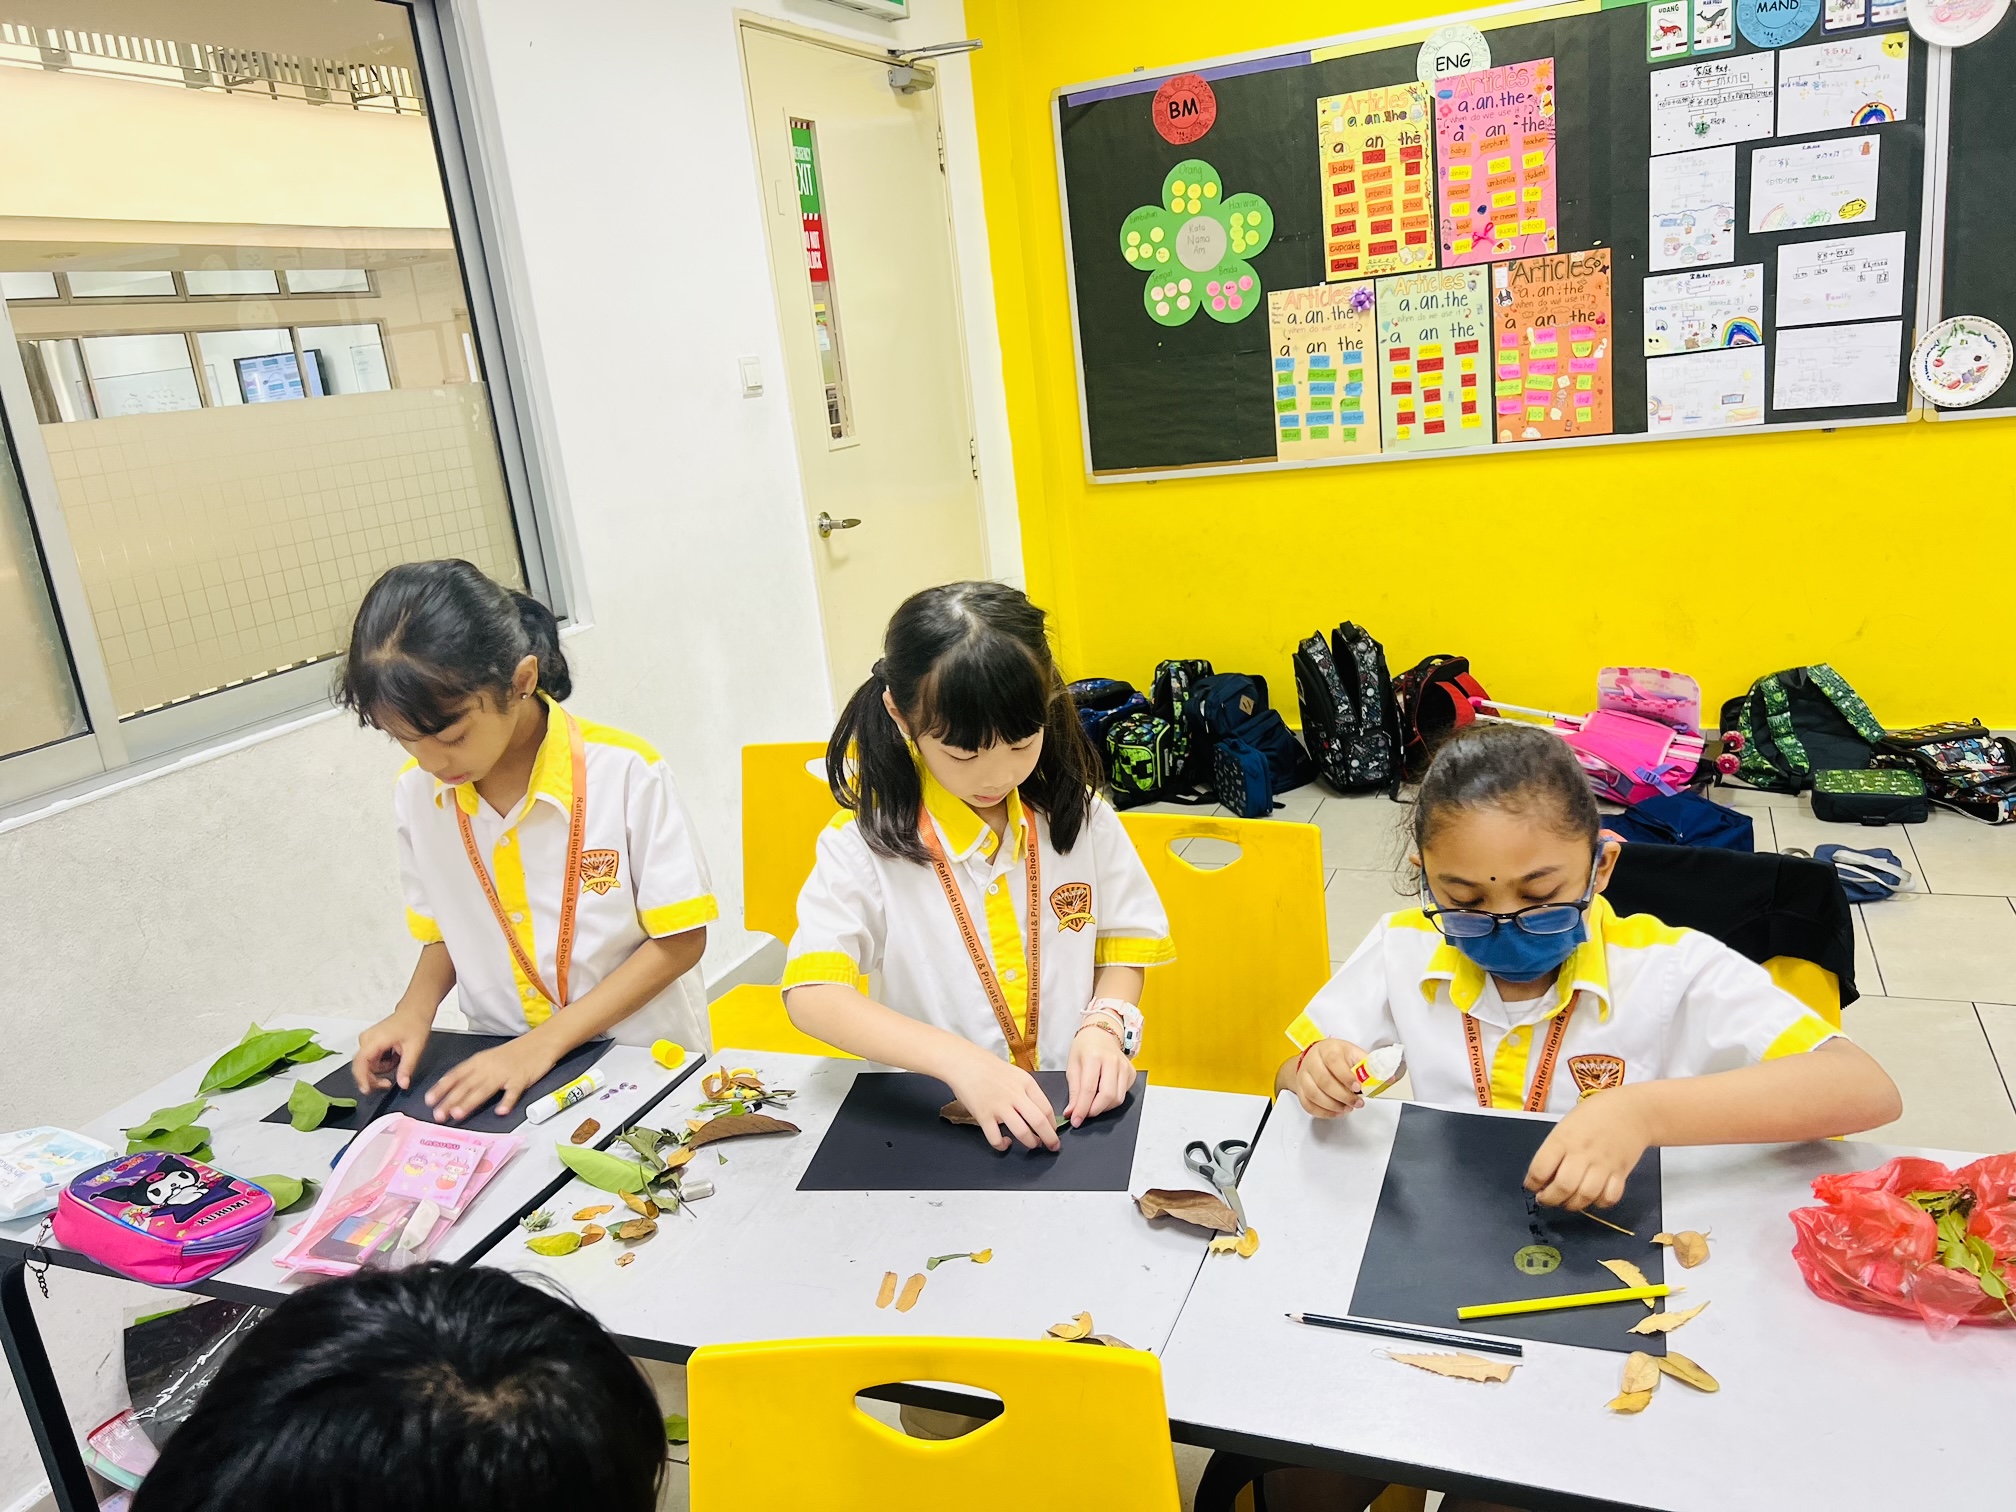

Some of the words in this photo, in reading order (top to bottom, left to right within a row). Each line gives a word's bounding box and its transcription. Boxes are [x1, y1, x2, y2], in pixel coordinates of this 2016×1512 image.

[1658, 4, 1680, 14] UDANG
[1757, 0, 1799, 13] MAND
[1436, 53, 1471, 72] ENG
[1454, 66, 1530, 98] Articles
[1169, 98, 1199, 119] BM
[1340, 88, 1409, 116] Articles
[1453, 131, 1464, 141] a
[1486, 124, 1505, 137] an
[1521, 117, 1545, 133] the
[1333, 143, 1344, 153] a
[1365, 136, 1384, 148] an
[1398, 132, 1421, 145] the
[797, 163, 814, 196] XIT
[1332, 163, 1354, 174] baby
[1338, 182, 1353, 194] ball
[1339, 202, 1356, 215] book
[1330, 241, 1360, 253] cupcake
[1511, 254, 1596, 285] Articles
[1394, 270, 1466, 296] Articles
[1283, 285, 1353, 311] Articles
[1390, 332, 1401, 343] a
[1419, 327, 1439, 340] an
[1449, 322, 1475, 338] the
[1505, 319, 1516, 329] a
[1535, 314, 1556, 327] an
[1569, 310, 1596, 323] the
[1280, 345, 1290, 357] a
[1306, 341, 1327, 354] an
[1337, 336, 1363, 352] the
[572, 796, 584, 837] Rafflesia
[567, 837, 580, 895] International
[1029, 843, 1038, 882] Schools
[563, 904, 574, 936] Private
[936, 862, 957, 903] Rafflesia
[953, 902, 982, 962] International
[981, 970, 1000, 1004] Private
[996, 1004, 1016, 1041] Schools
[1029, 993, 1038, 1035] Rafflesia
[1471, 1045, 1482, 1084] Private
[1535, 1021, 1562, 1092] International
[420, 1139, 461, 1150] LABUBU
[197, 1199, 251, 1226] KUROMI
